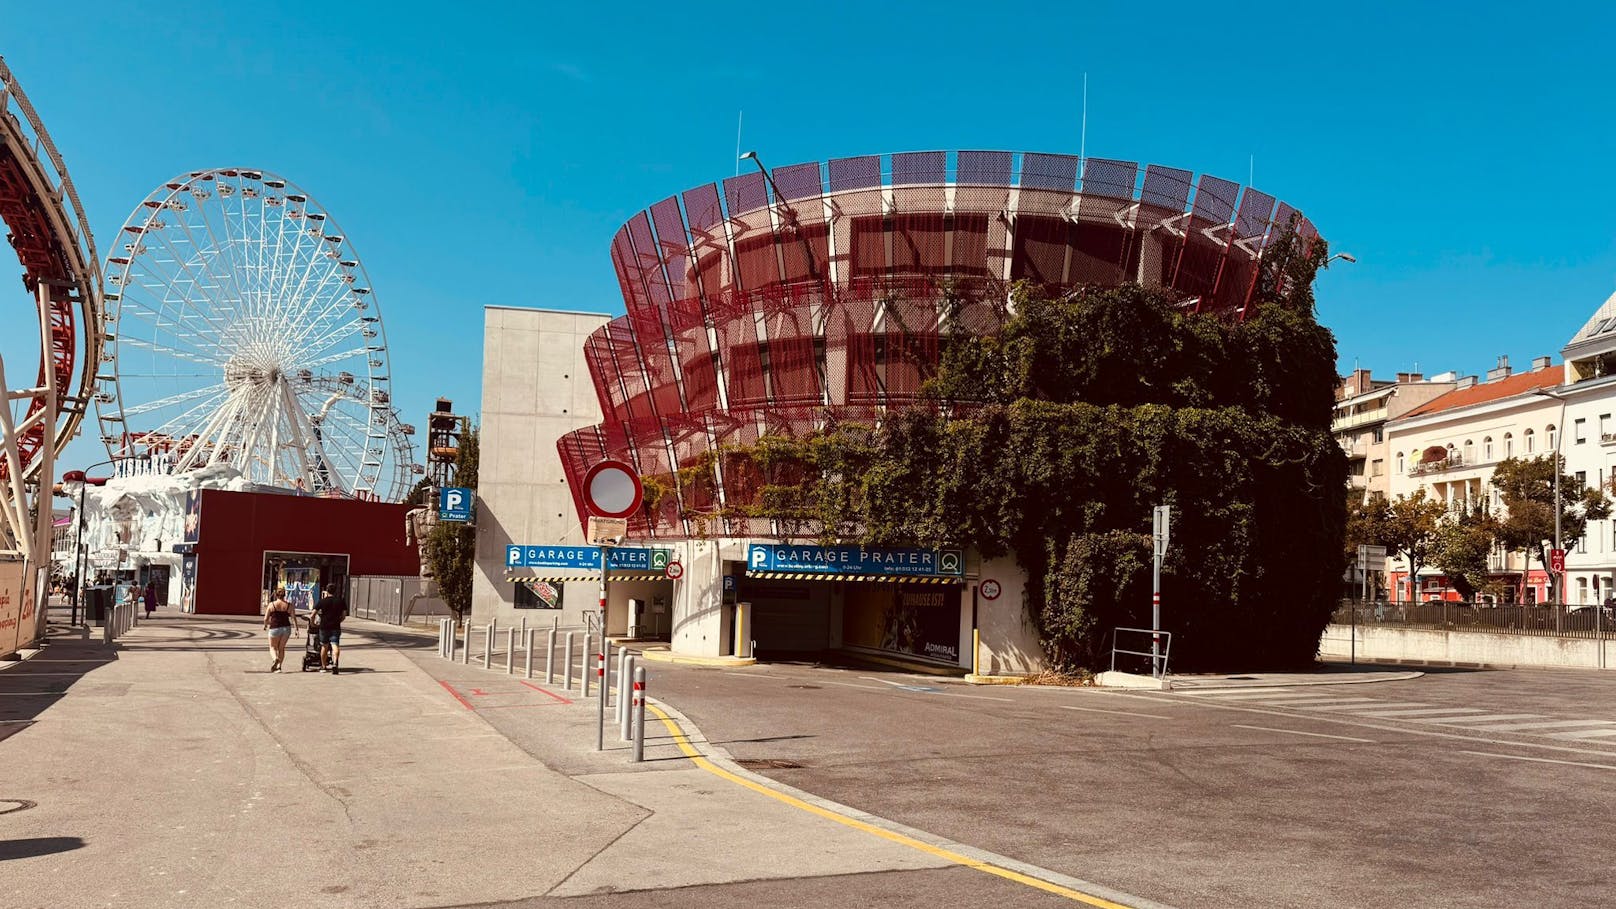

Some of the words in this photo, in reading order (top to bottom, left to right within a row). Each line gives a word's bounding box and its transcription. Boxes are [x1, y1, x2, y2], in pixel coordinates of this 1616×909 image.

[114, 455, 169, 478] EISBERG
[528, 549, 584, 560] GARAGE
[592, 551, 646, 562] PATER
[776, 549, 849, 562] GARAGE
[860, 551, 932, 564] PRATER
[924, 641, 957, 657] ADMIRAL
